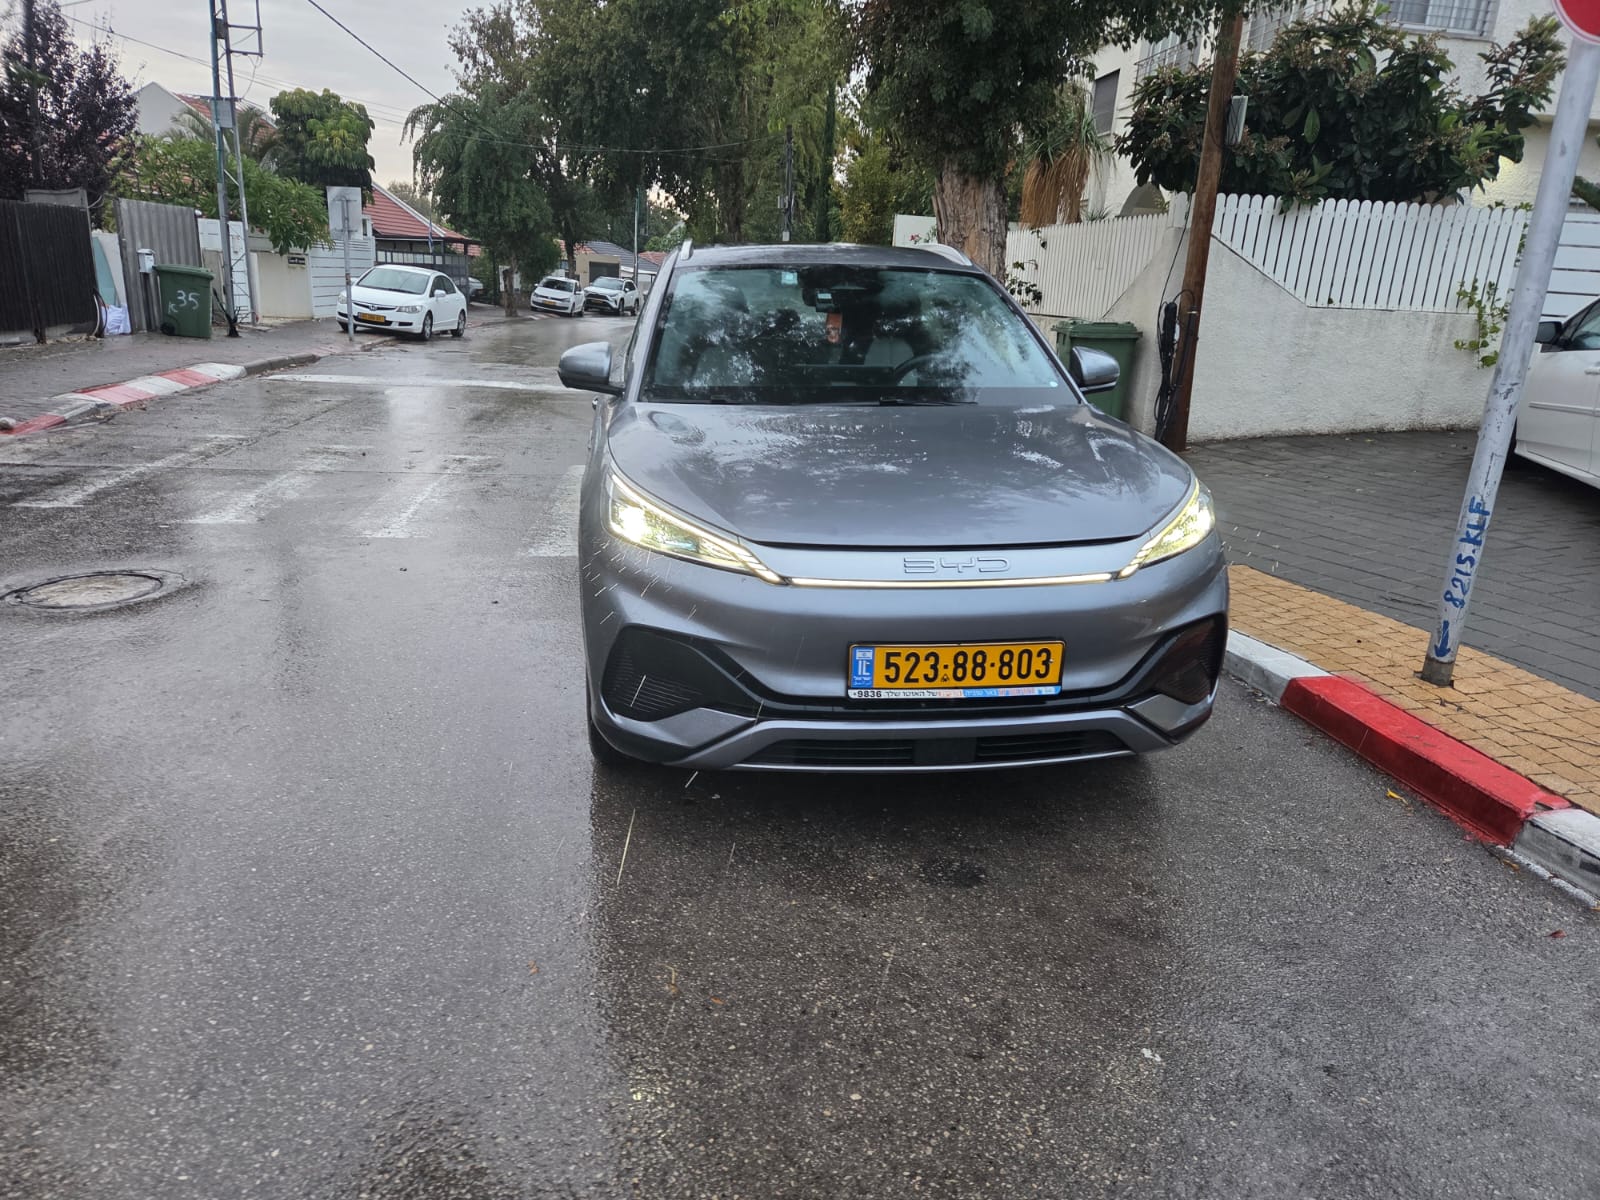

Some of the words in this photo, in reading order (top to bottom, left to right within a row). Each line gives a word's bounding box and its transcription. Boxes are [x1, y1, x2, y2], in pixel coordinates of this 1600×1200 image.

[177, 290, 200, 310] 35
[903, 556, 1011, 574] BYD
[858, 660, 870, 676] IL
